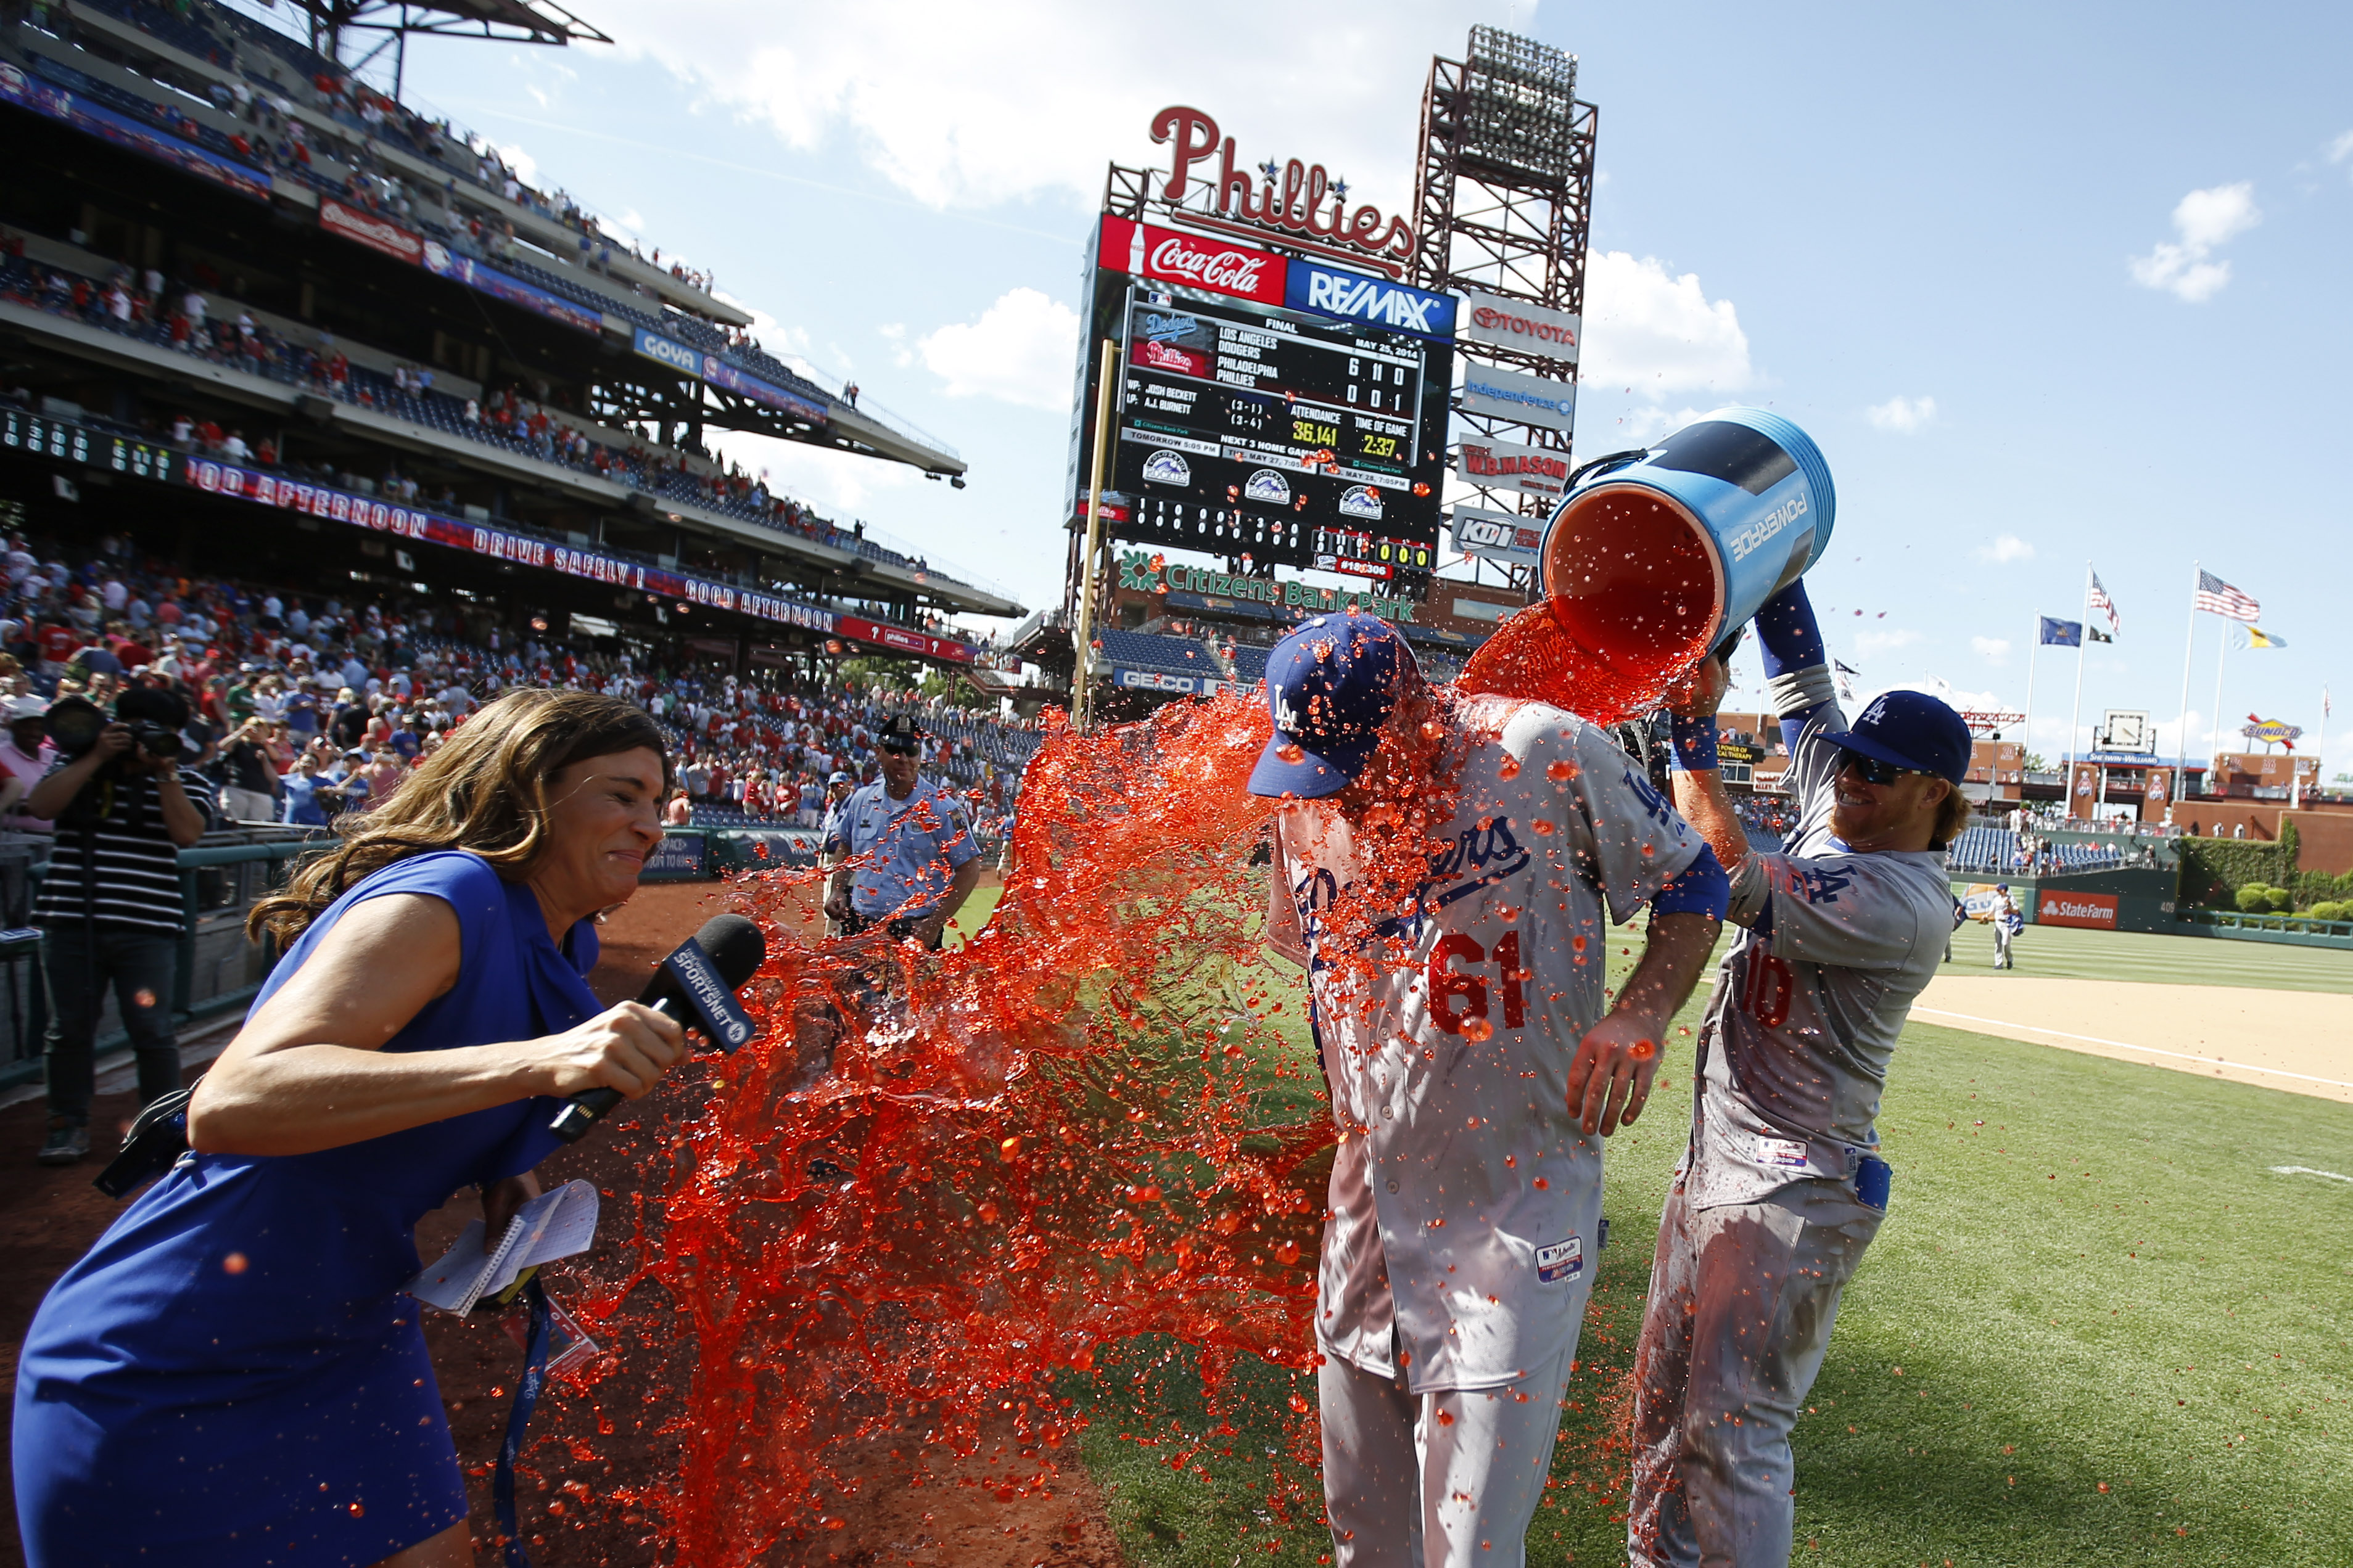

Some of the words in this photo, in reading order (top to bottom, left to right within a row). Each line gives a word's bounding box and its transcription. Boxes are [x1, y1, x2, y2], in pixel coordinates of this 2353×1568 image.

[1150, 105, 1417, 259] Phillies
[1150, 238, 1267, 293] Coca-Cola
[1308, 271, 1433, 333] RE/MAX
[1266, 318, 1298, 334] FINAL
[1500, 313, 1576, 346] TOYOTA
[1218, 340, 1261, 359] DODGERS
[1219, 327, 1237, 341] LOS
[1238, 331, 1277, 350] ANGELES
[1355, 339, 1377, 350] MAY
[1395, 347, 1418, 359] 2014
[644, 335, 694, 369] GOYA
[1216, 369, 1256, 387] PHILLIES
[1218, 356, 1278, 379] PHILADELPHIA
[1348, 357, 1359, 376] 6
[1372, 363, 1383, 381] 11
[1393, 367, 1404, 385] 0
[1127, 379, 1141, 391] WP:
[1145, 384, 1164, 395] JOSH
[1166, 387, 1198, 402] BECKETT
[1346, 384, 1358, 403] 0
[1370, 389, 1382, 408] 0
[1395, 393, 1401, 411] 1
[1467, 379, 1556, 409] Independence
[1126, 393, 1139, 404] LP:
[1160, 400, 1192, 414] BURNETT
[1290, 404, 1341, 424] ATTENDANCE
[1293, 421, 1337, 446] 36,141
[1354, 416, 1373, 430] TIME
[1374, 421, 1384, 432] OF
[1385, 422, 1407, 437] GAME
[1131, 432, 1181, 446] TOMORROW
[1184, 441, 1200, 449] 5:05
[1221, 434, 1248, 446] NEXT
[1249, 440, 1256, 448] 3
[1257, 441, 1287, 453] HOME
[1363, 434, 1396, 457] 2:37
[1249, 453, 1267, 461] MAY
[1147, 468, 1187, 482] ROCKIES
[1345, 470, 1362, 479] MAY
[255, 474, 428, 539] AFTERNOON
[1730, 493, 1808, 562] POWERADE
[473, 528, 546, 567] DRIVE
[554, 547, 629, 586] SAFELY
[1380, 544, 1390, 560] 0
[1399, 547, 1409, 564] 0
[1417, 550, 1427, 567] 0
[1166, 564, 1279, 601] Citizens
[1285, 580, 1354, 612] Bank
[1358, 591, 1416, 622] Park
[685, 579, 735, 609] GOOD
[740, 592, 833, 633] AFTERNOON
[1123, 670, 1193, 692] GEICO
[1274, 684, 1300, 733] LA
[1863, 696, 1890, 725] LA
[2245, 725, 2300, 737] SUNOCO
[1729, 751, 1752, 760] THERAPY
[2161, 901, 2175, 913] 409
[674, 951, 733, 1026] SPORTSNET
[1429, 930, 1525, 1035] 61
[1744, 944, 1793, 1028] 10
